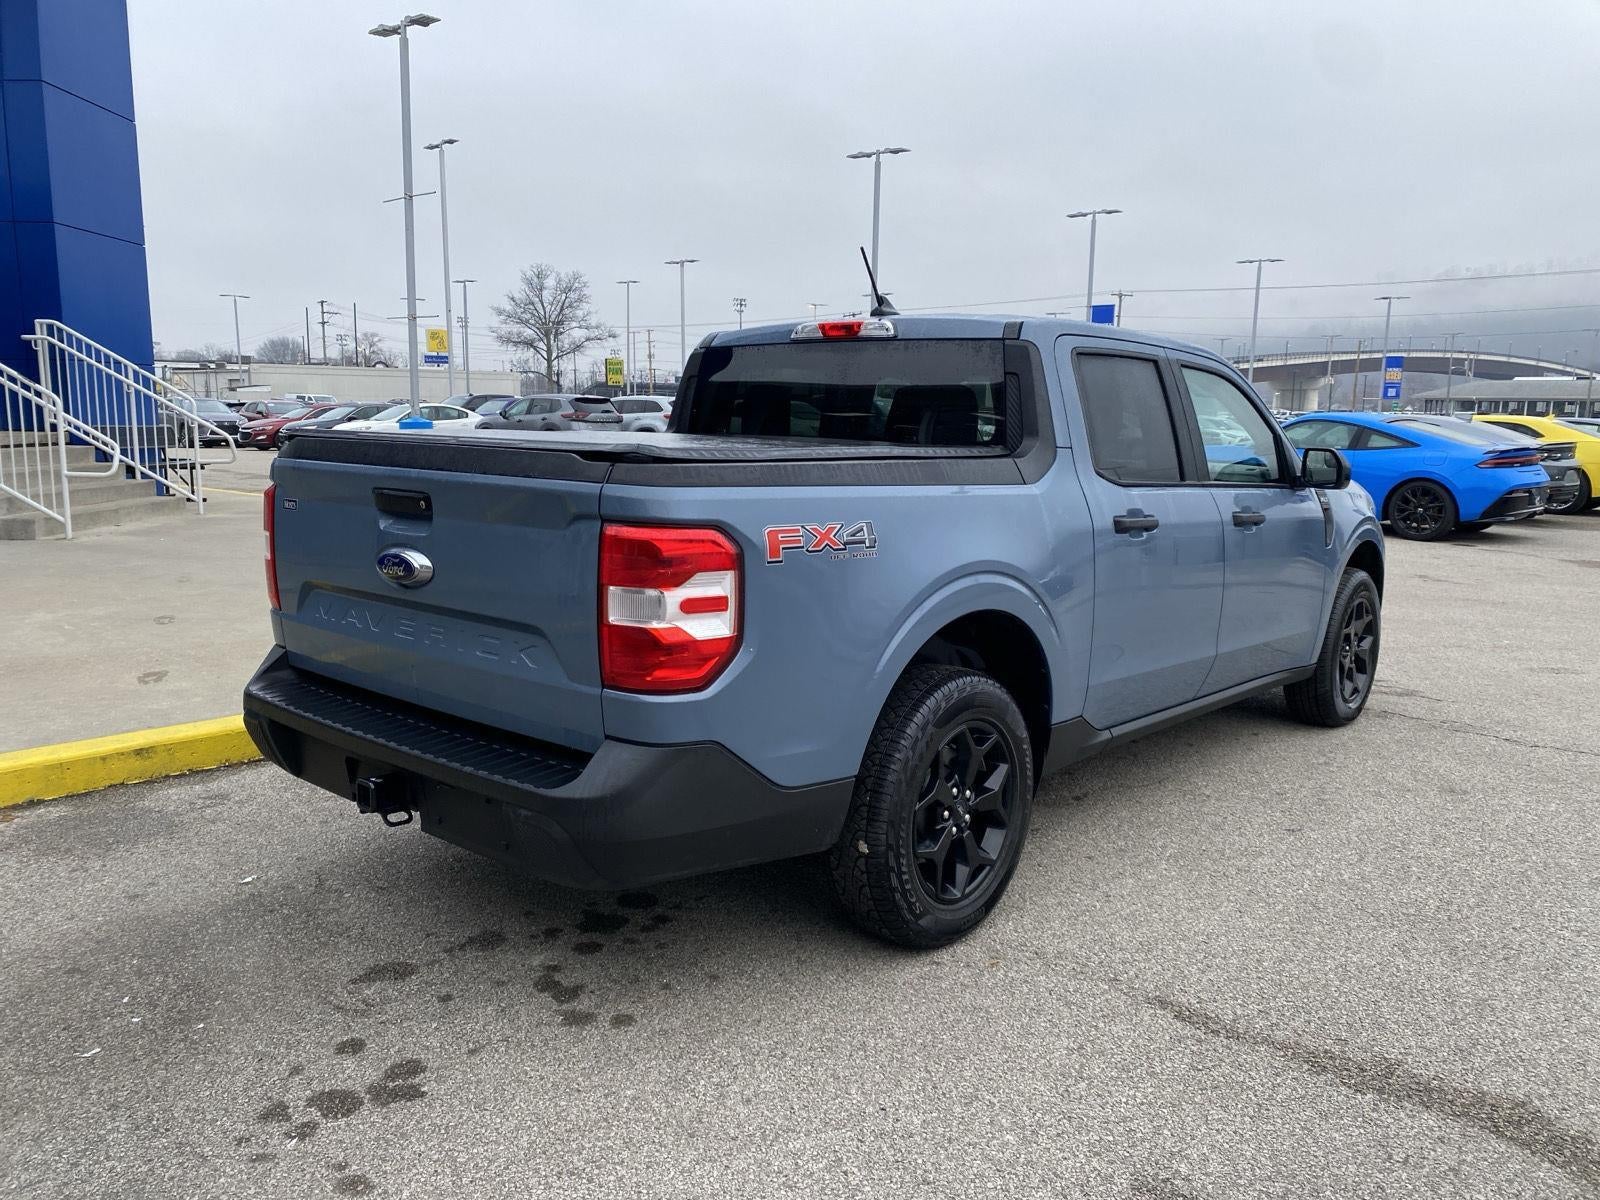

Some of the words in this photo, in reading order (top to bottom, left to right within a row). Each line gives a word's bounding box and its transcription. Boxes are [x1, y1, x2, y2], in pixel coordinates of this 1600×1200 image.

[382, 556, 405, 576] Ford
[763, 520, 878, 566] FX4
[314, 604, 539, 669] MAVERICK
